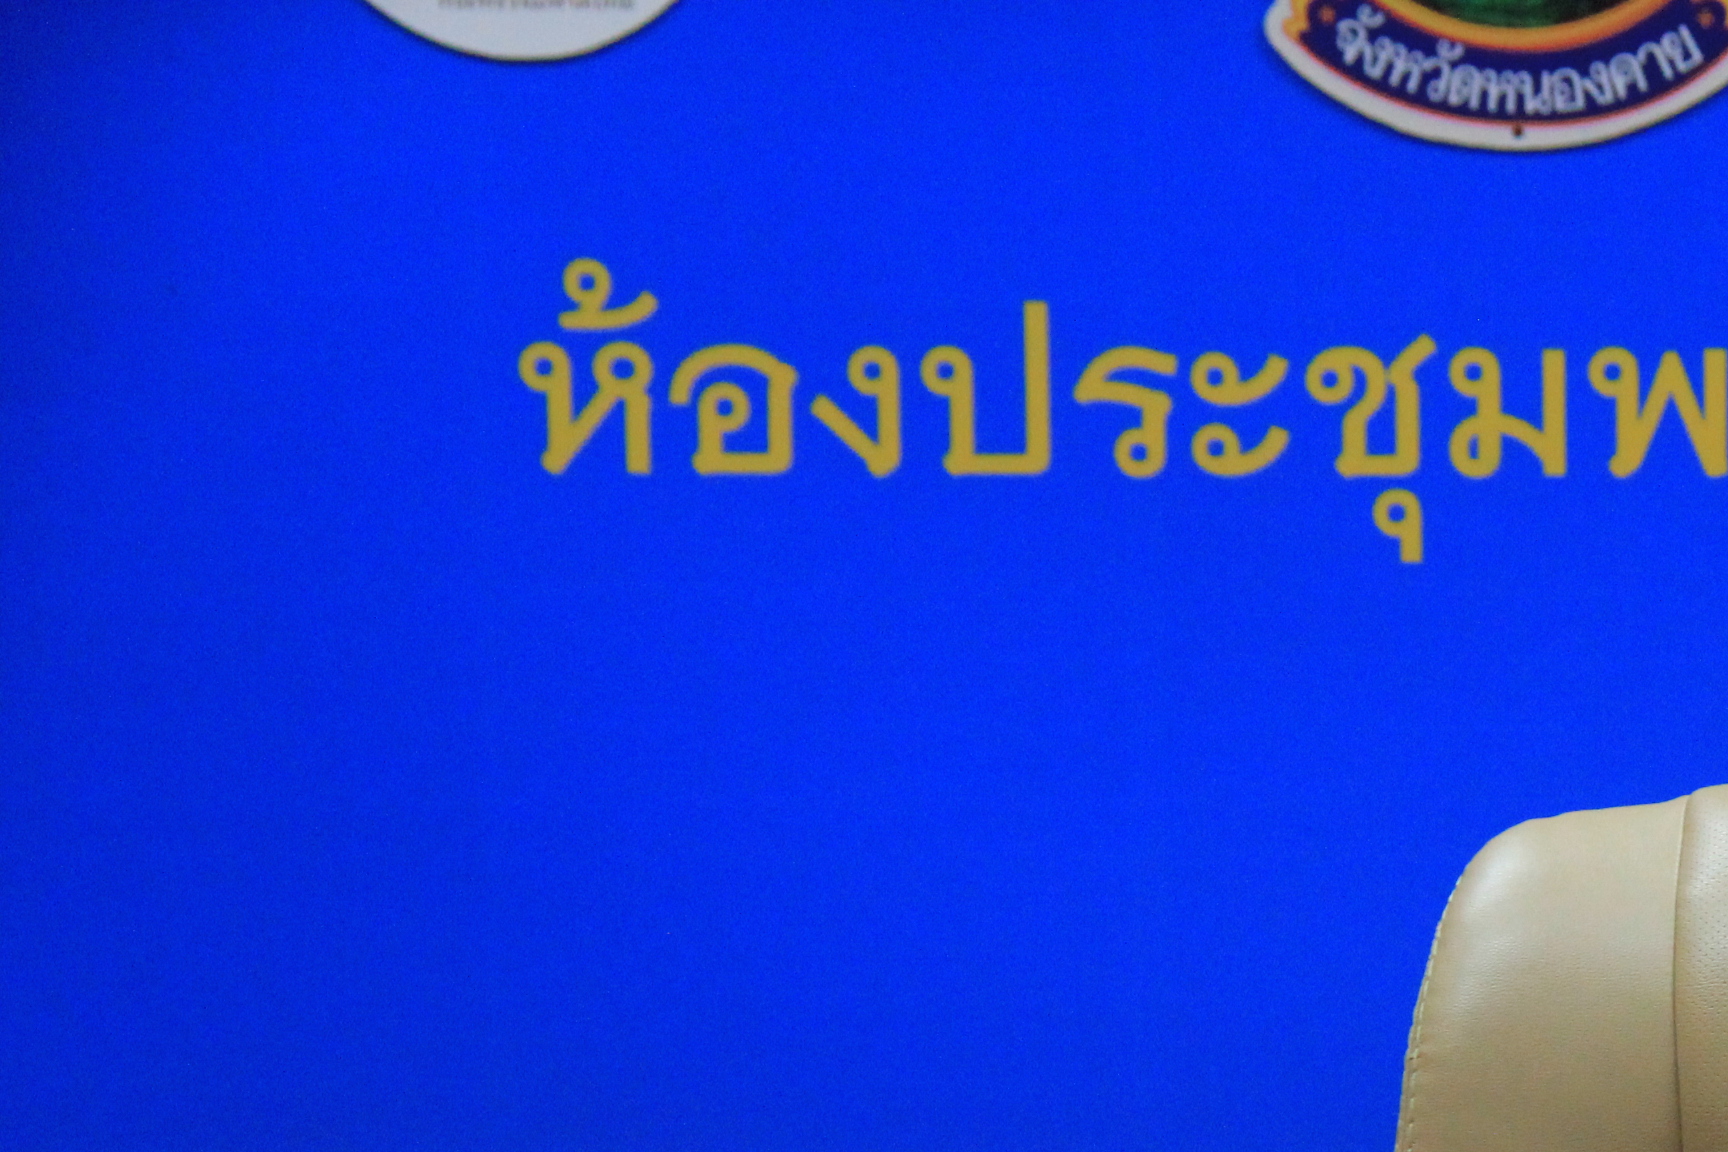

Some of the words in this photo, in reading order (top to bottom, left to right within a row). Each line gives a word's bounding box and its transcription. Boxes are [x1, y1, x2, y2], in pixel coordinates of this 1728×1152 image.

[1335, 4, 1705, 115] จังหวัดหนองคาย
